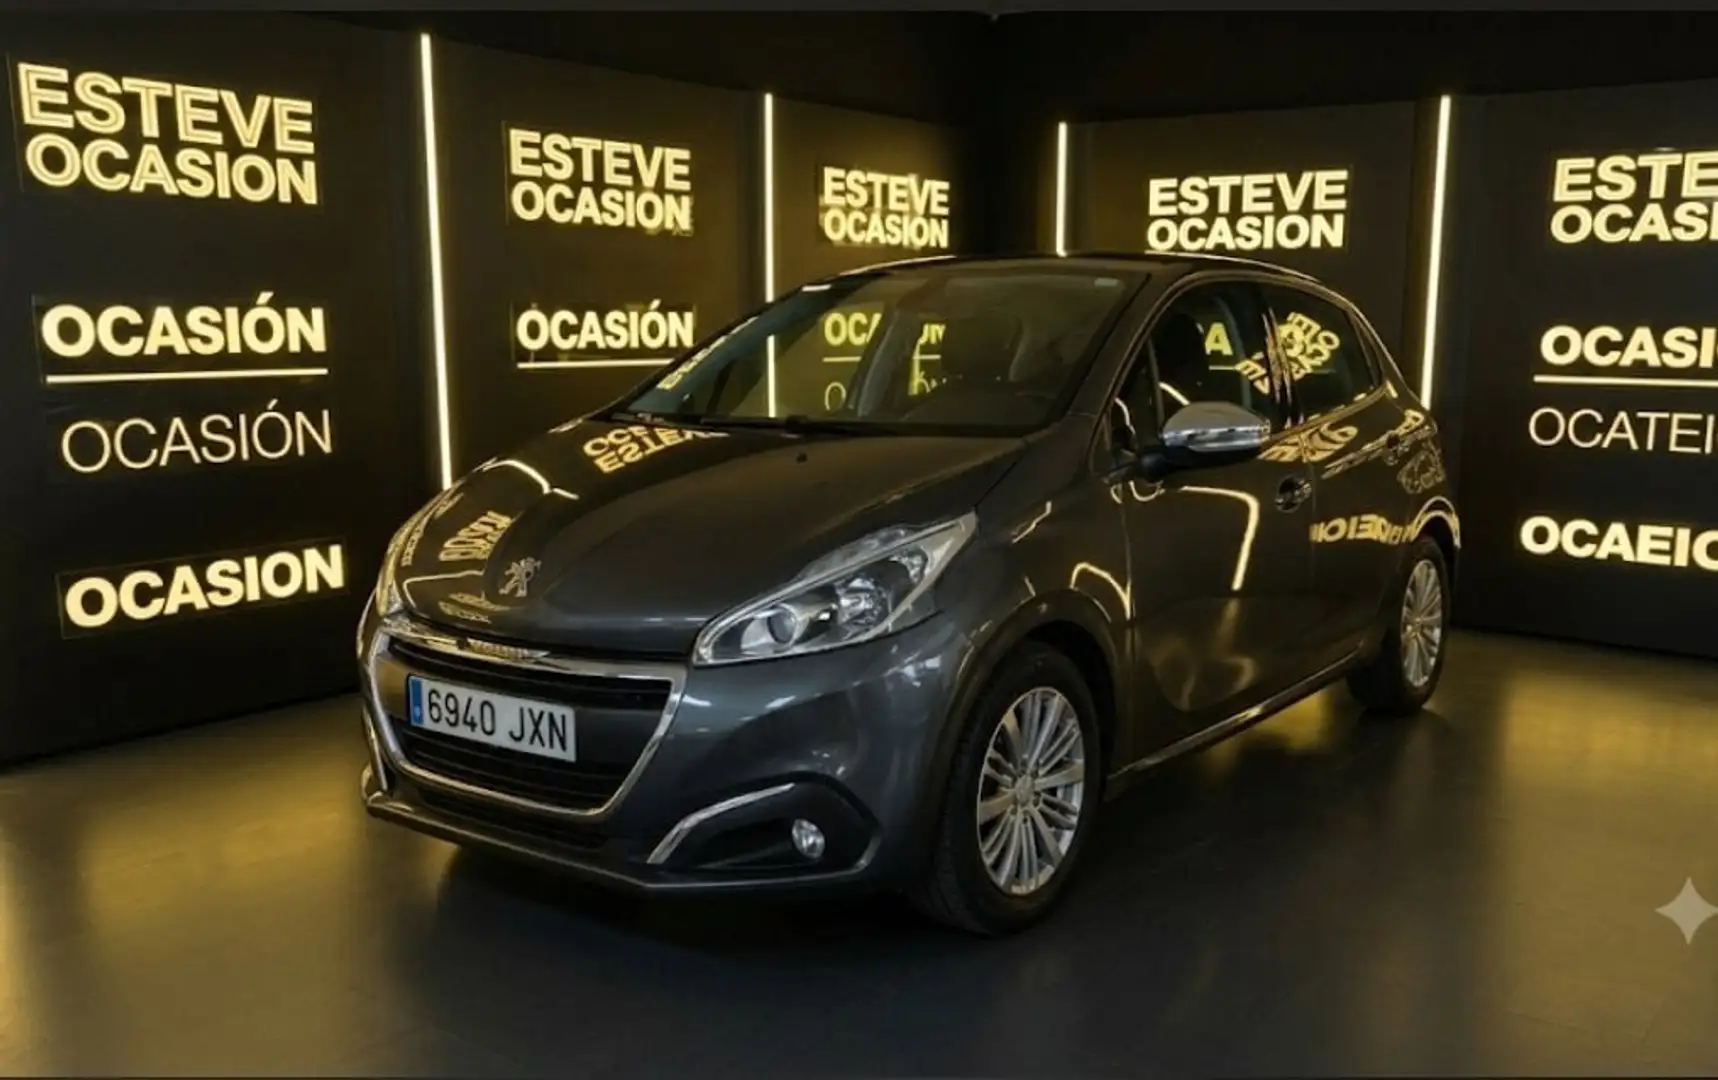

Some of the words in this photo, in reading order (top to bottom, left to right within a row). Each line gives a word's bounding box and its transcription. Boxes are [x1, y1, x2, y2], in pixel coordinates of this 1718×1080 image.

[18, 62, 315, 154] ESTEVE
[25, 133, 318, 205] OCASION
[509, 128, 692, 191] ESTEVE
[511, 180, 692, 231] OCASION
[823, 166, 950, 215] ESTEVE
[1147, 169, 1349, 216] ESTEVE
[823, 208, 949, 248] OCASION
[1145, 213, 1345, 250] OCASION
[41, 291, 327, 357] OCASIÓN
[516, 299, 694, 350] OCASIÓN
[1541, 325, 1718, 368] OCASI
[62, 399, 332, 472] OCASIÓN
[65, 544, 345, 627] OCASION
[427, 688, 497, 737] 6940
[508, 706, 568, 753] JXN
